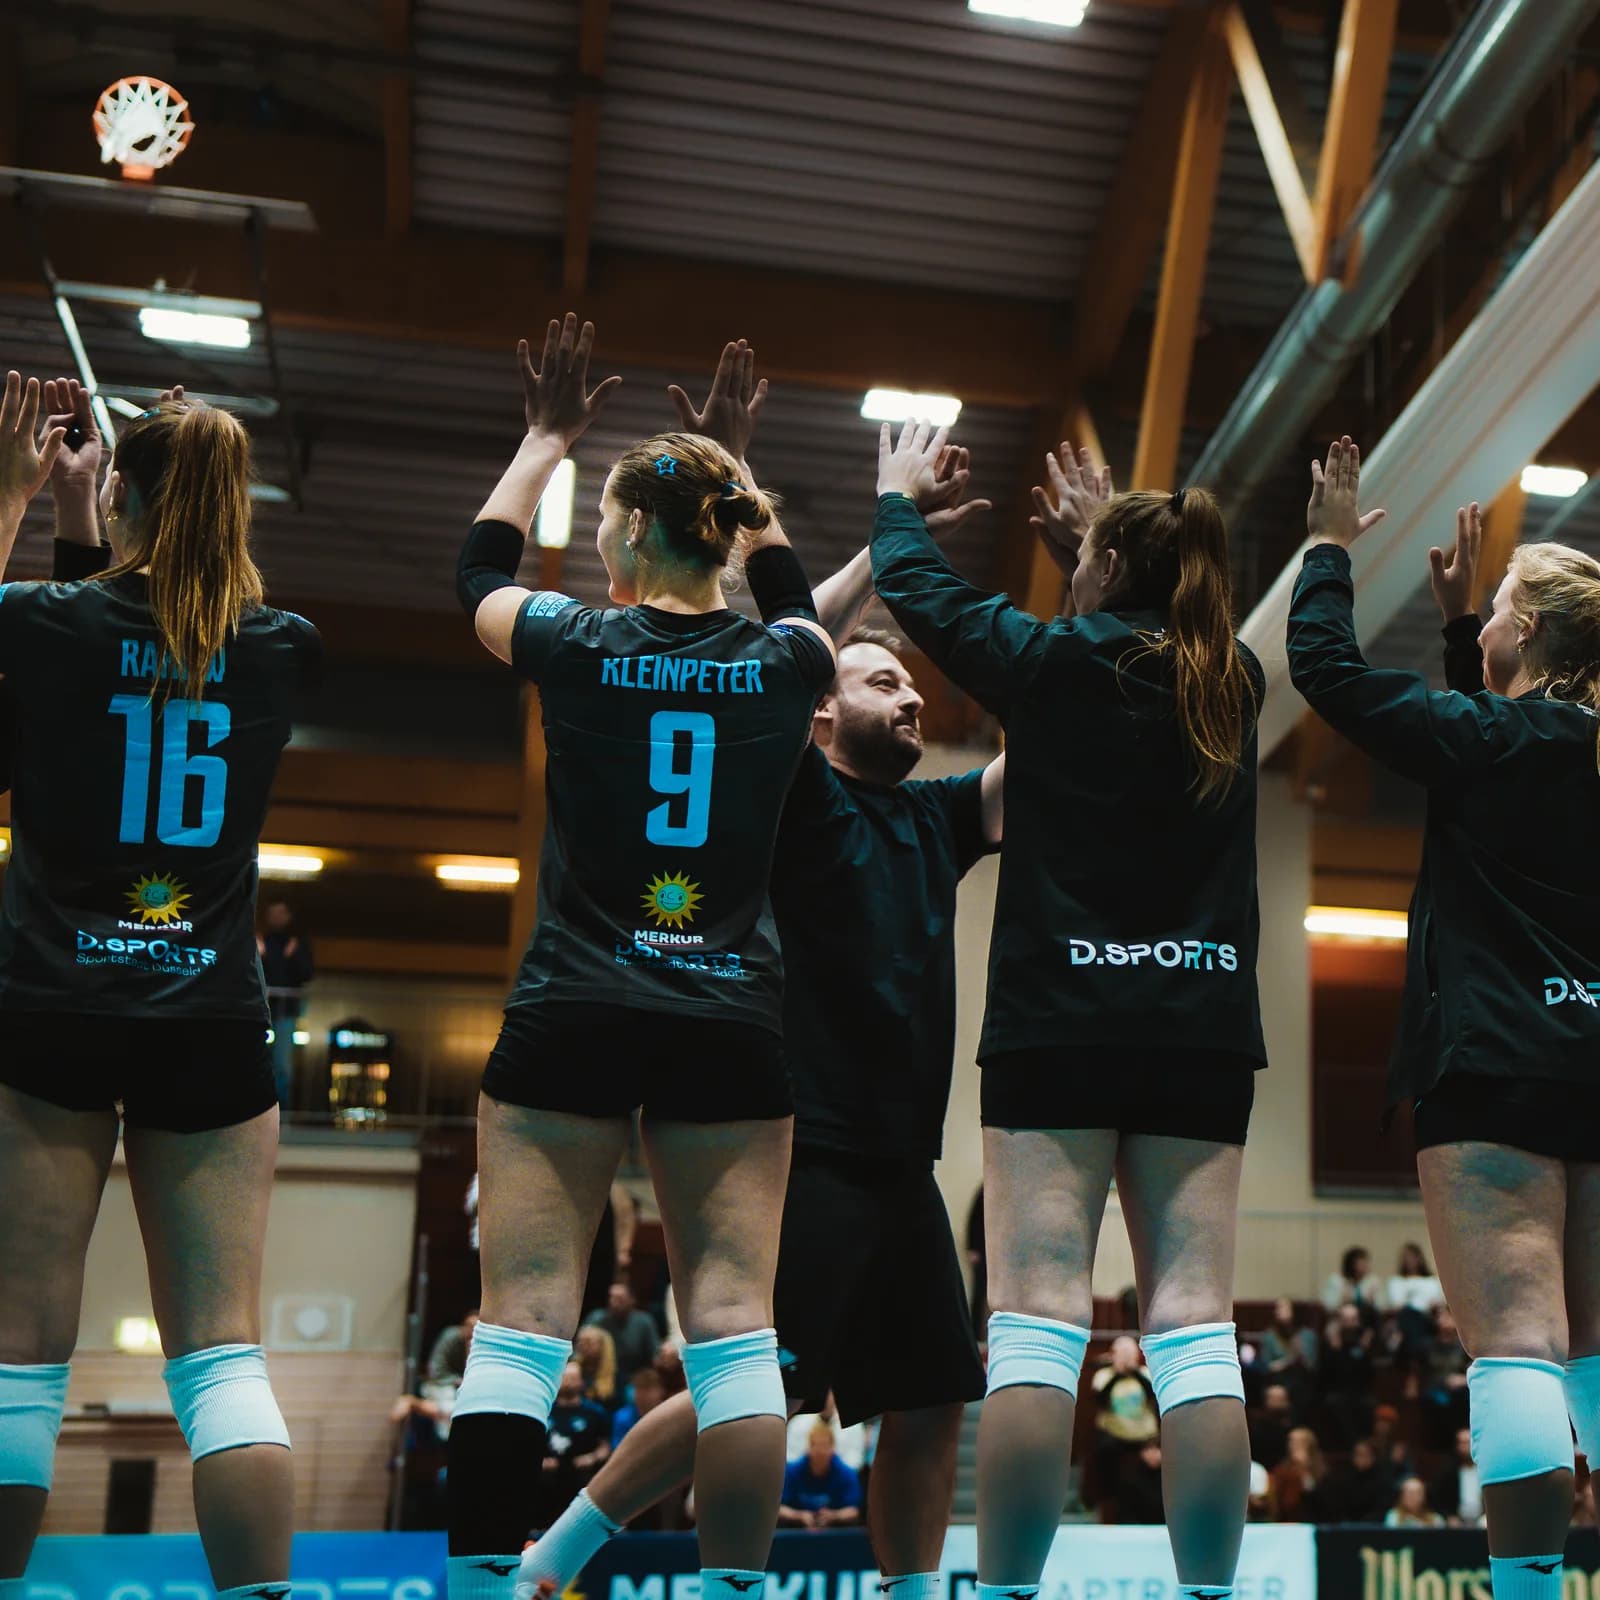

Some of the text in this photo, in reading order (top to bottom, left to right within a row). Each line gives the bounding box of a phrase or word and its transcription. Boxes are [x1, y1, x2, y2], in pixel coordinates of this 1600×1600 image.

[601, 655, 764, 693] KLEINPETER
[107, 694, 231, 847] 16
[646, 710, 716, 848] 9
[634, 929, 704, 944] MERKUR
[1069, 939, 1238, 972] D.SPORTS
